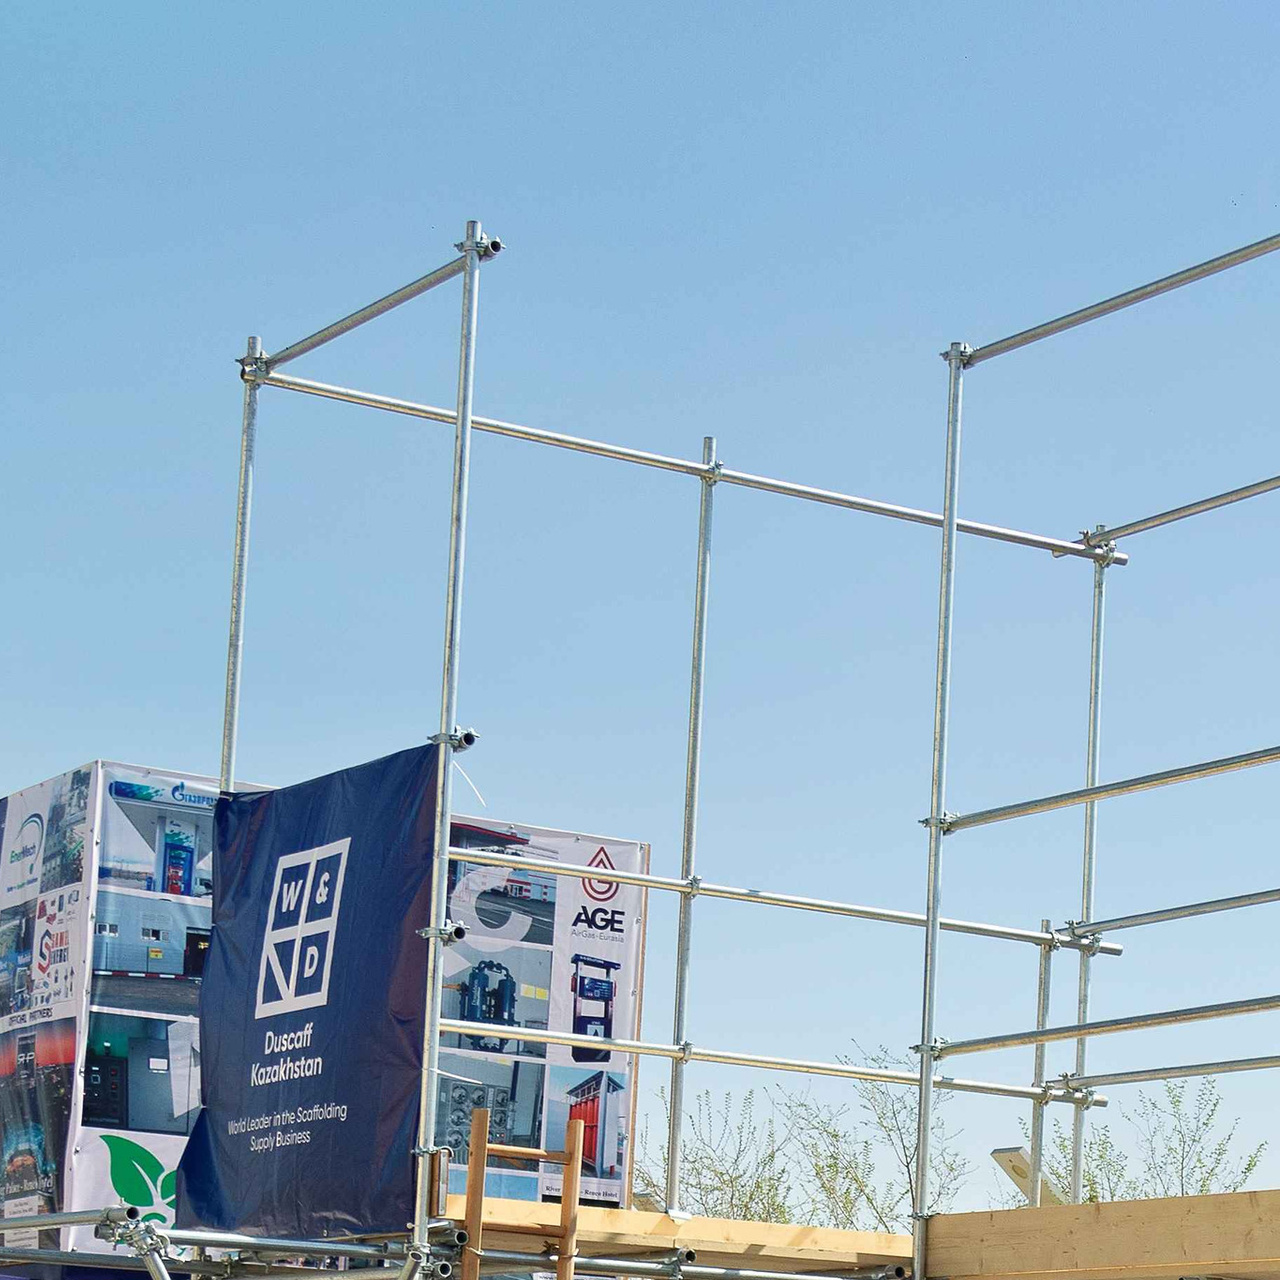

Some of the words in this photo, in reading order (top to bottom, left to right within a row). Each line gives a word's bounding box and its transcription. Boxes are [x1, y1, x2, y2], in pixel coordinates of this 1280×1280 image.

[571, 905, 625, 934] AGE
[264, 1022, 313, 1055] Duscaff
[250, 1054, 322, 1087] Kazakhstan
[228, 1118, 246, 1135] World
[247, 1112, 272, 1132] Leader
[273, 1111, 281, 1127] in
[281, 1108, 296, 1126] the
[297, 1103, 348, 1124] Scaffolding
[249, 1133, 275, 1152] Supply
[276, 1129, 311, 1147] Business
